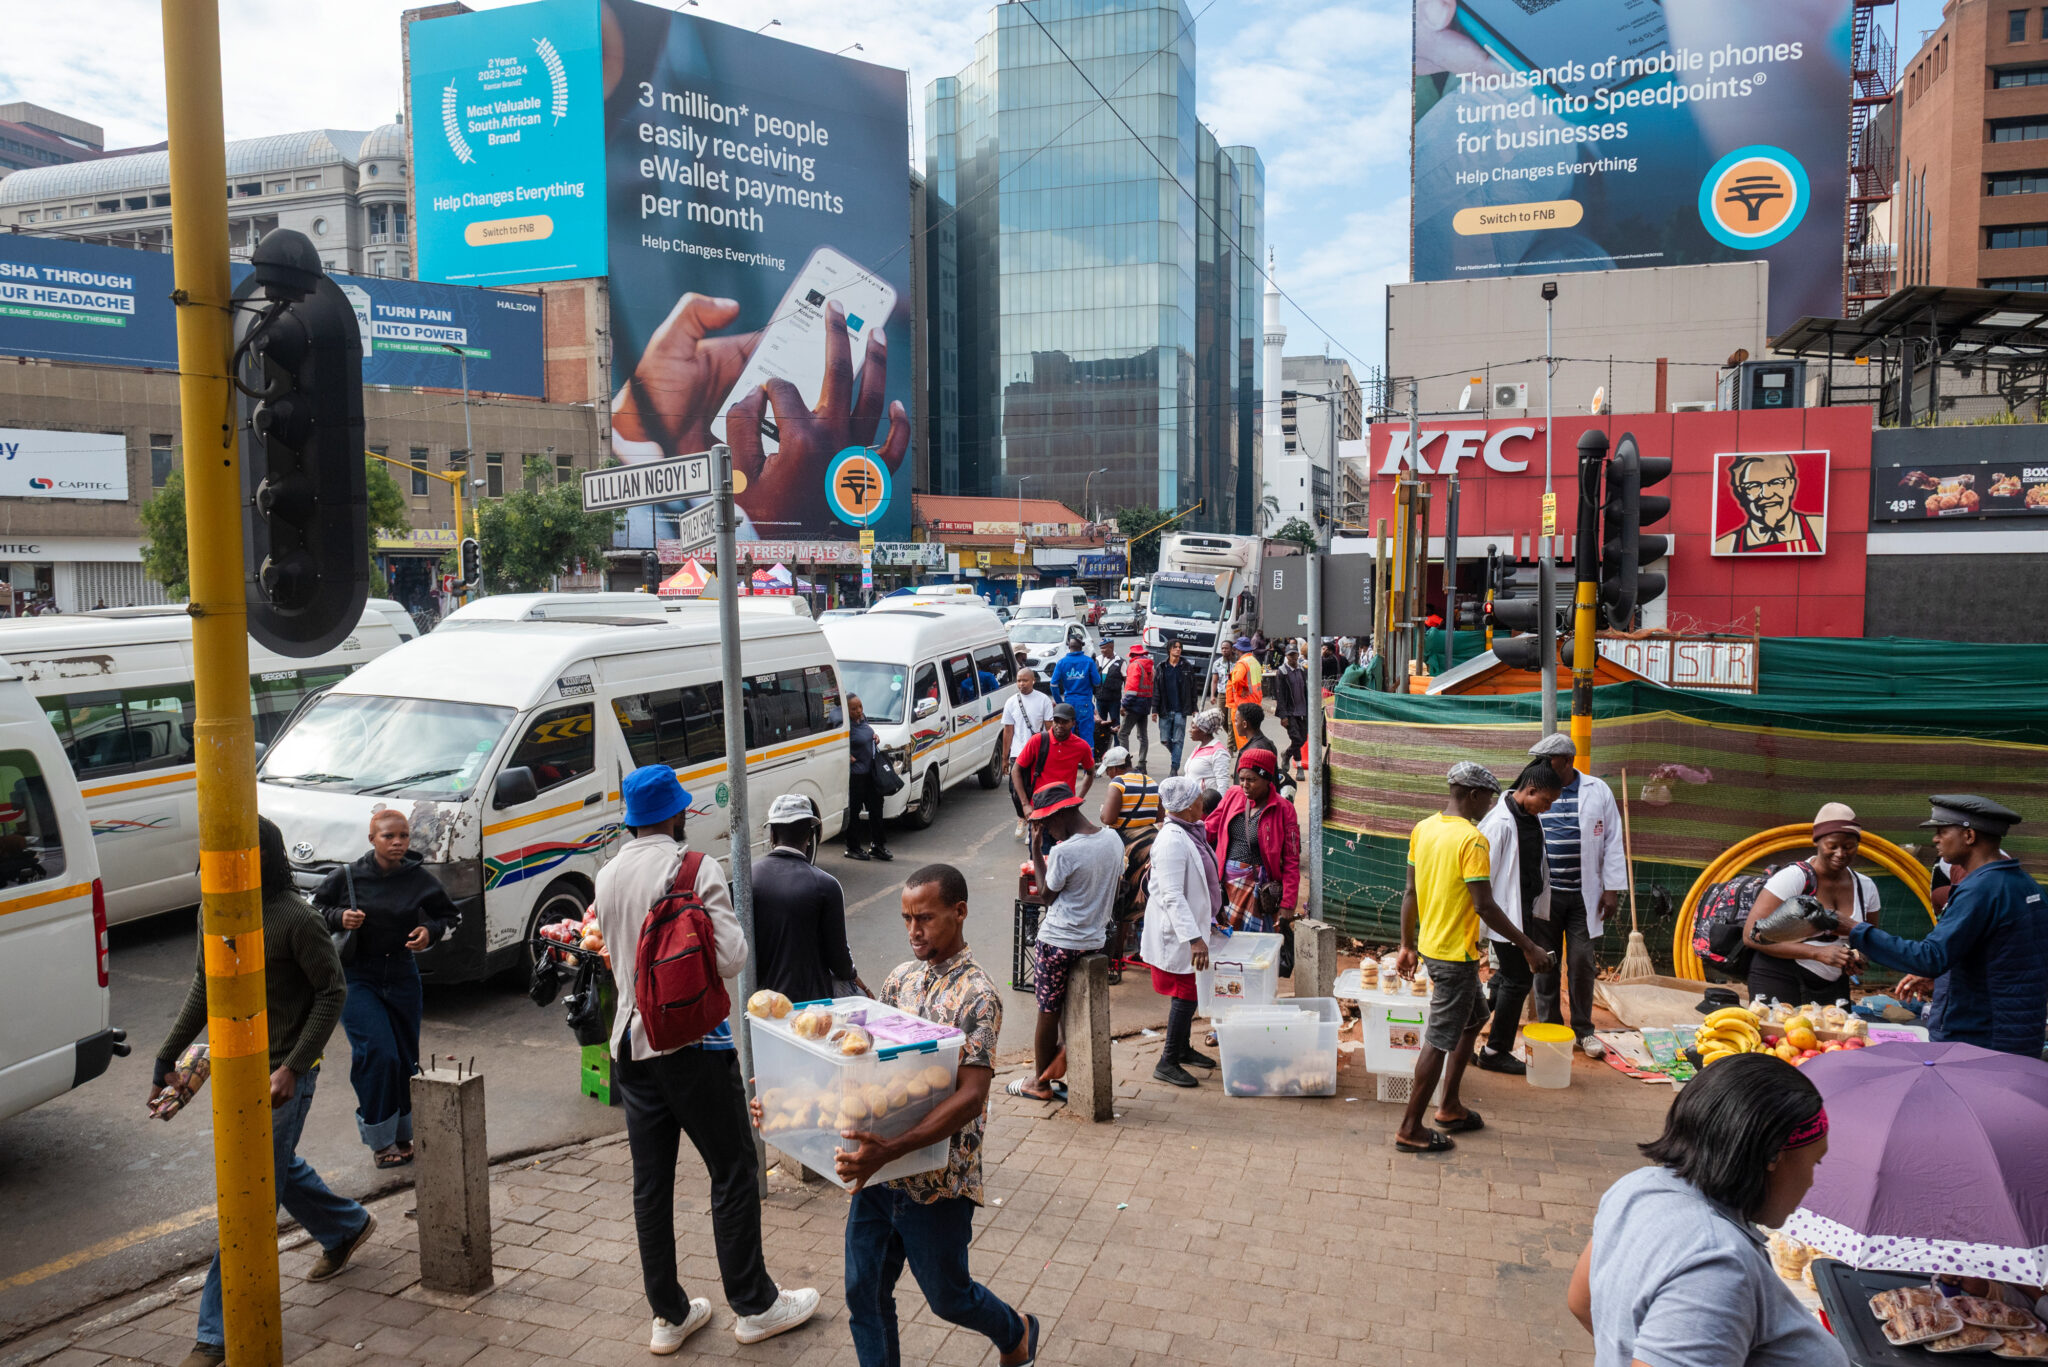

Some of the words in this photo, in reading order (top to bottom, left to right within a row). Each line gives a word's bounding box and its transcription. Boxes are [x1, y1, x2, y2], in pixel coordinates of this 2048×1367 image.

[488, 59, 494, 68] 2
[494, 57, 518, 68] Years
[1456, 59, 1585, 94] Thousands
[1590, 56, 1618, 79] of
[1621, 48, 1703, 78] mobile
[1709, 41, 1803, 72] phones
[478, 66, 528, 81] 2023-2024
[1456, 96, 1536, 124] turned
[1542, 94, 1589, 117] into
[1594, 72, 1767, 115] Speedpoints®
[466, 104, 493, 118] Most
[494, 97, 541, 115] Valuable
[638, 82, 654, 108] 3
[754, 113, 829, 147] people
[468, 118, 500, 133] South
[501, 114, 541, 128] African
[488, 130, 520, 146] Brand
[1456, 131, 1492, 154] for
[1496, 120, 1629, 151] businesses
[639, 122, 708, 158] easily
[714, 138, 816, 182] receiving
[1456, 169, 1489, 186] Help
[1492, 164, 1554, 183] Changes
[1557, 156, 1638, 178] Everything
[640, 155, 730, 192] eWallet
[735, 176, 844, 214] payments
[433, 197, 461, 212] Help
[462, 190, 514, 208] Changes
[516, 181, 585, 202] Everything
[641, 193, 682, 220] per
[688, 200, 764, 233] month
[1480, 212, 1515, 226] Switch
[1518, 212, 1531, 223] to
[1533, 210, 1556, 221] FNB
[482, 225, 508, 239] Switch
[508, 225, 518, 235] to
[519, 223, 535, 234] FNB
[642, 234, 670, 252] Help
[672, 240, 723, 260] Changes
[725, 248, 786, 272] Everything
[42, 268, 132, 290] THROUGH
[0, 286, 28, 300] UR
[34, 289, 130, 310] HEADACHE
[496, 301, 536, 313] HALEON
[8, 308, 32, 316] SAME
[32, 310, 72, 320] GRAND-PA
[376, 304, 416, 319] TURN
[420, 308, 452, 322] PAIN
[376, 324, 410, 337] INTO
[415, 327, 464, 341] POWER
[58, 480, 112, 490] CAPITEC
[590, 472, 641, 504] LILLIAN
[644, 465, 687, 496] NGOYI
[691, 462, 702, 479] ST
[682, 515, 700, 545] PIXLEY
[928, 522, 945, 530] TST
[946, 522, 953, 530] ME
[954, 522, 972, 530] TAVERN
[754, 545, 795, 559] FRESH
[798, 546, 840, 559] MEATS
[1089, 562, 1120, 572] PERFUME
[1160, 576, 1188, 584] DELIVERING
[260, 672, 288, 682] EMERGENCY
[288, 670, 298, 679] EXIT
[560, 685, 585, 697] EMERGENCY
